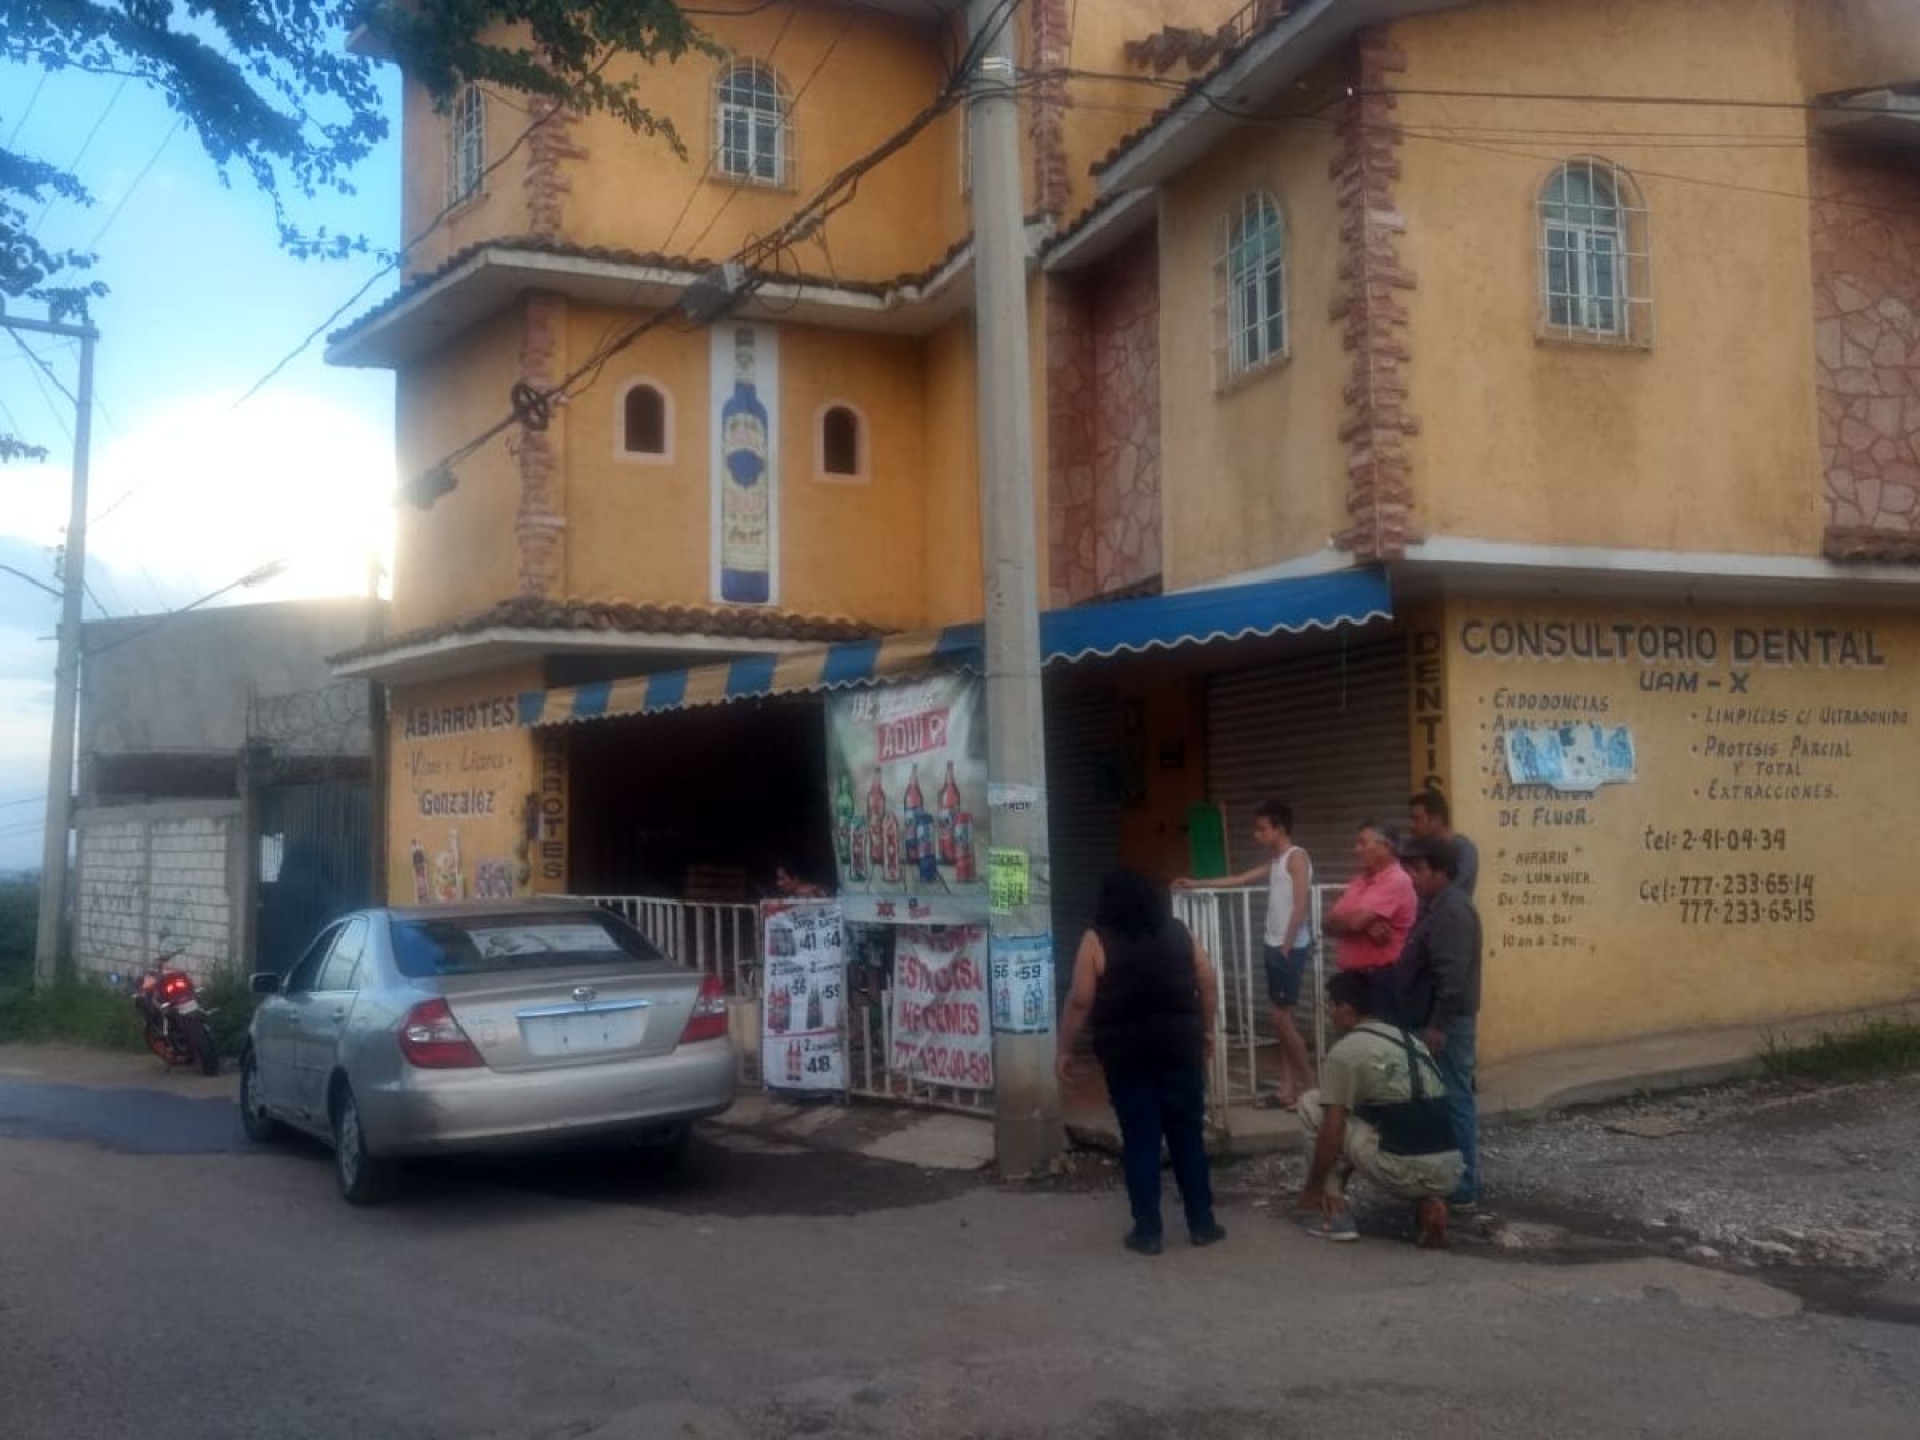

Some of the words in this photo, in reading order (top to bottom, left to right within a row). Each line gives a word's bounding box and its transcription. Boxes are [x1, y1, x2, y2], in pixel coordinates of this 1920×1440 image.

[1461, 620, 1717, 660] CONSULTORIO
[1733, 626, 1885, 665] DENTAL
[1639, 670, 1699, 692] UAM
[1729, 671, 1749, 693] X
[1493, 687, 1609, 712] ENDODONCIAS
[404, 697, 516, 738] ABARROTES
[1819, 706, 1908, 725] ULTRASONIDO
[1704, 735, 1779, 758] PROTESIS
[1789, 735, 1853, 758] PARCIAL
[1756, 761, 1803, 777] TOTAL
[1498, 808, 1520, 828] DE
